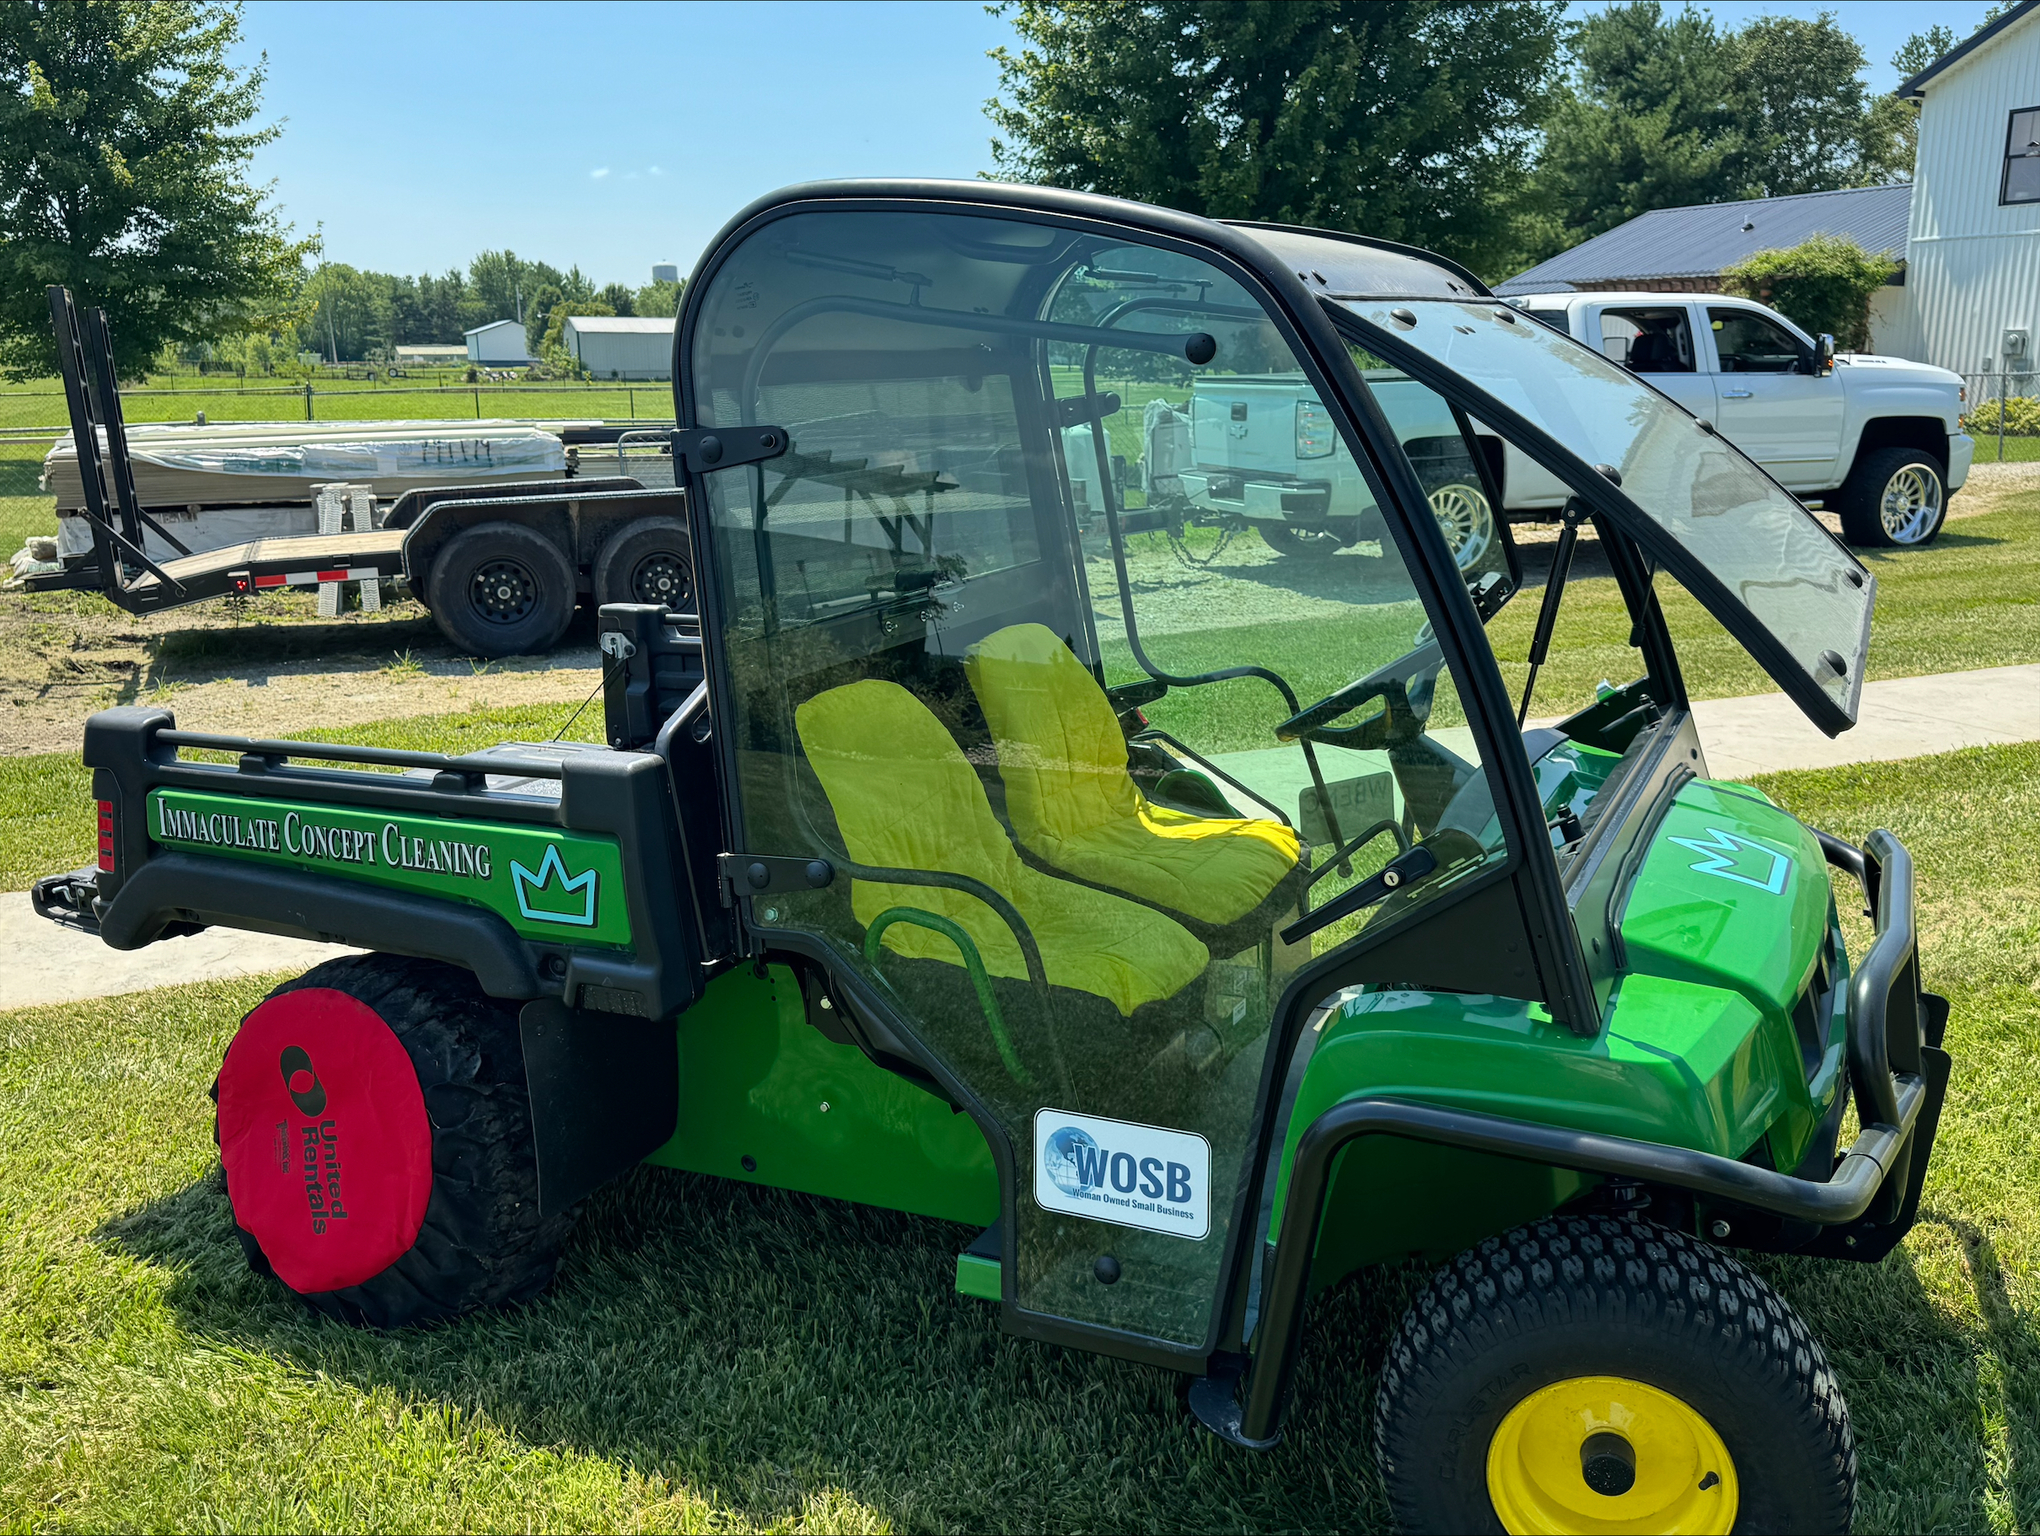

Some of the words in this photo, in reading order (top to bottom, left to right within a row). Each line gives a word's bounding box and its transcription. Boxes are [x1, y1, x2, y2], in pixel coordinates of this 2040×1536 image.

[301, 1126, 329, 1235] Rentals
[320, 1120, 348, 1219] United
[1072, 1188, 1101, 1202] Woman
[1103, 1193, 1130, 1208] Owned
[1131, 1199, 1155, 1212] Small
[1157, 1204, 1194, 1220] Business
[1074, 1143, 1192, 1203] WOSB
